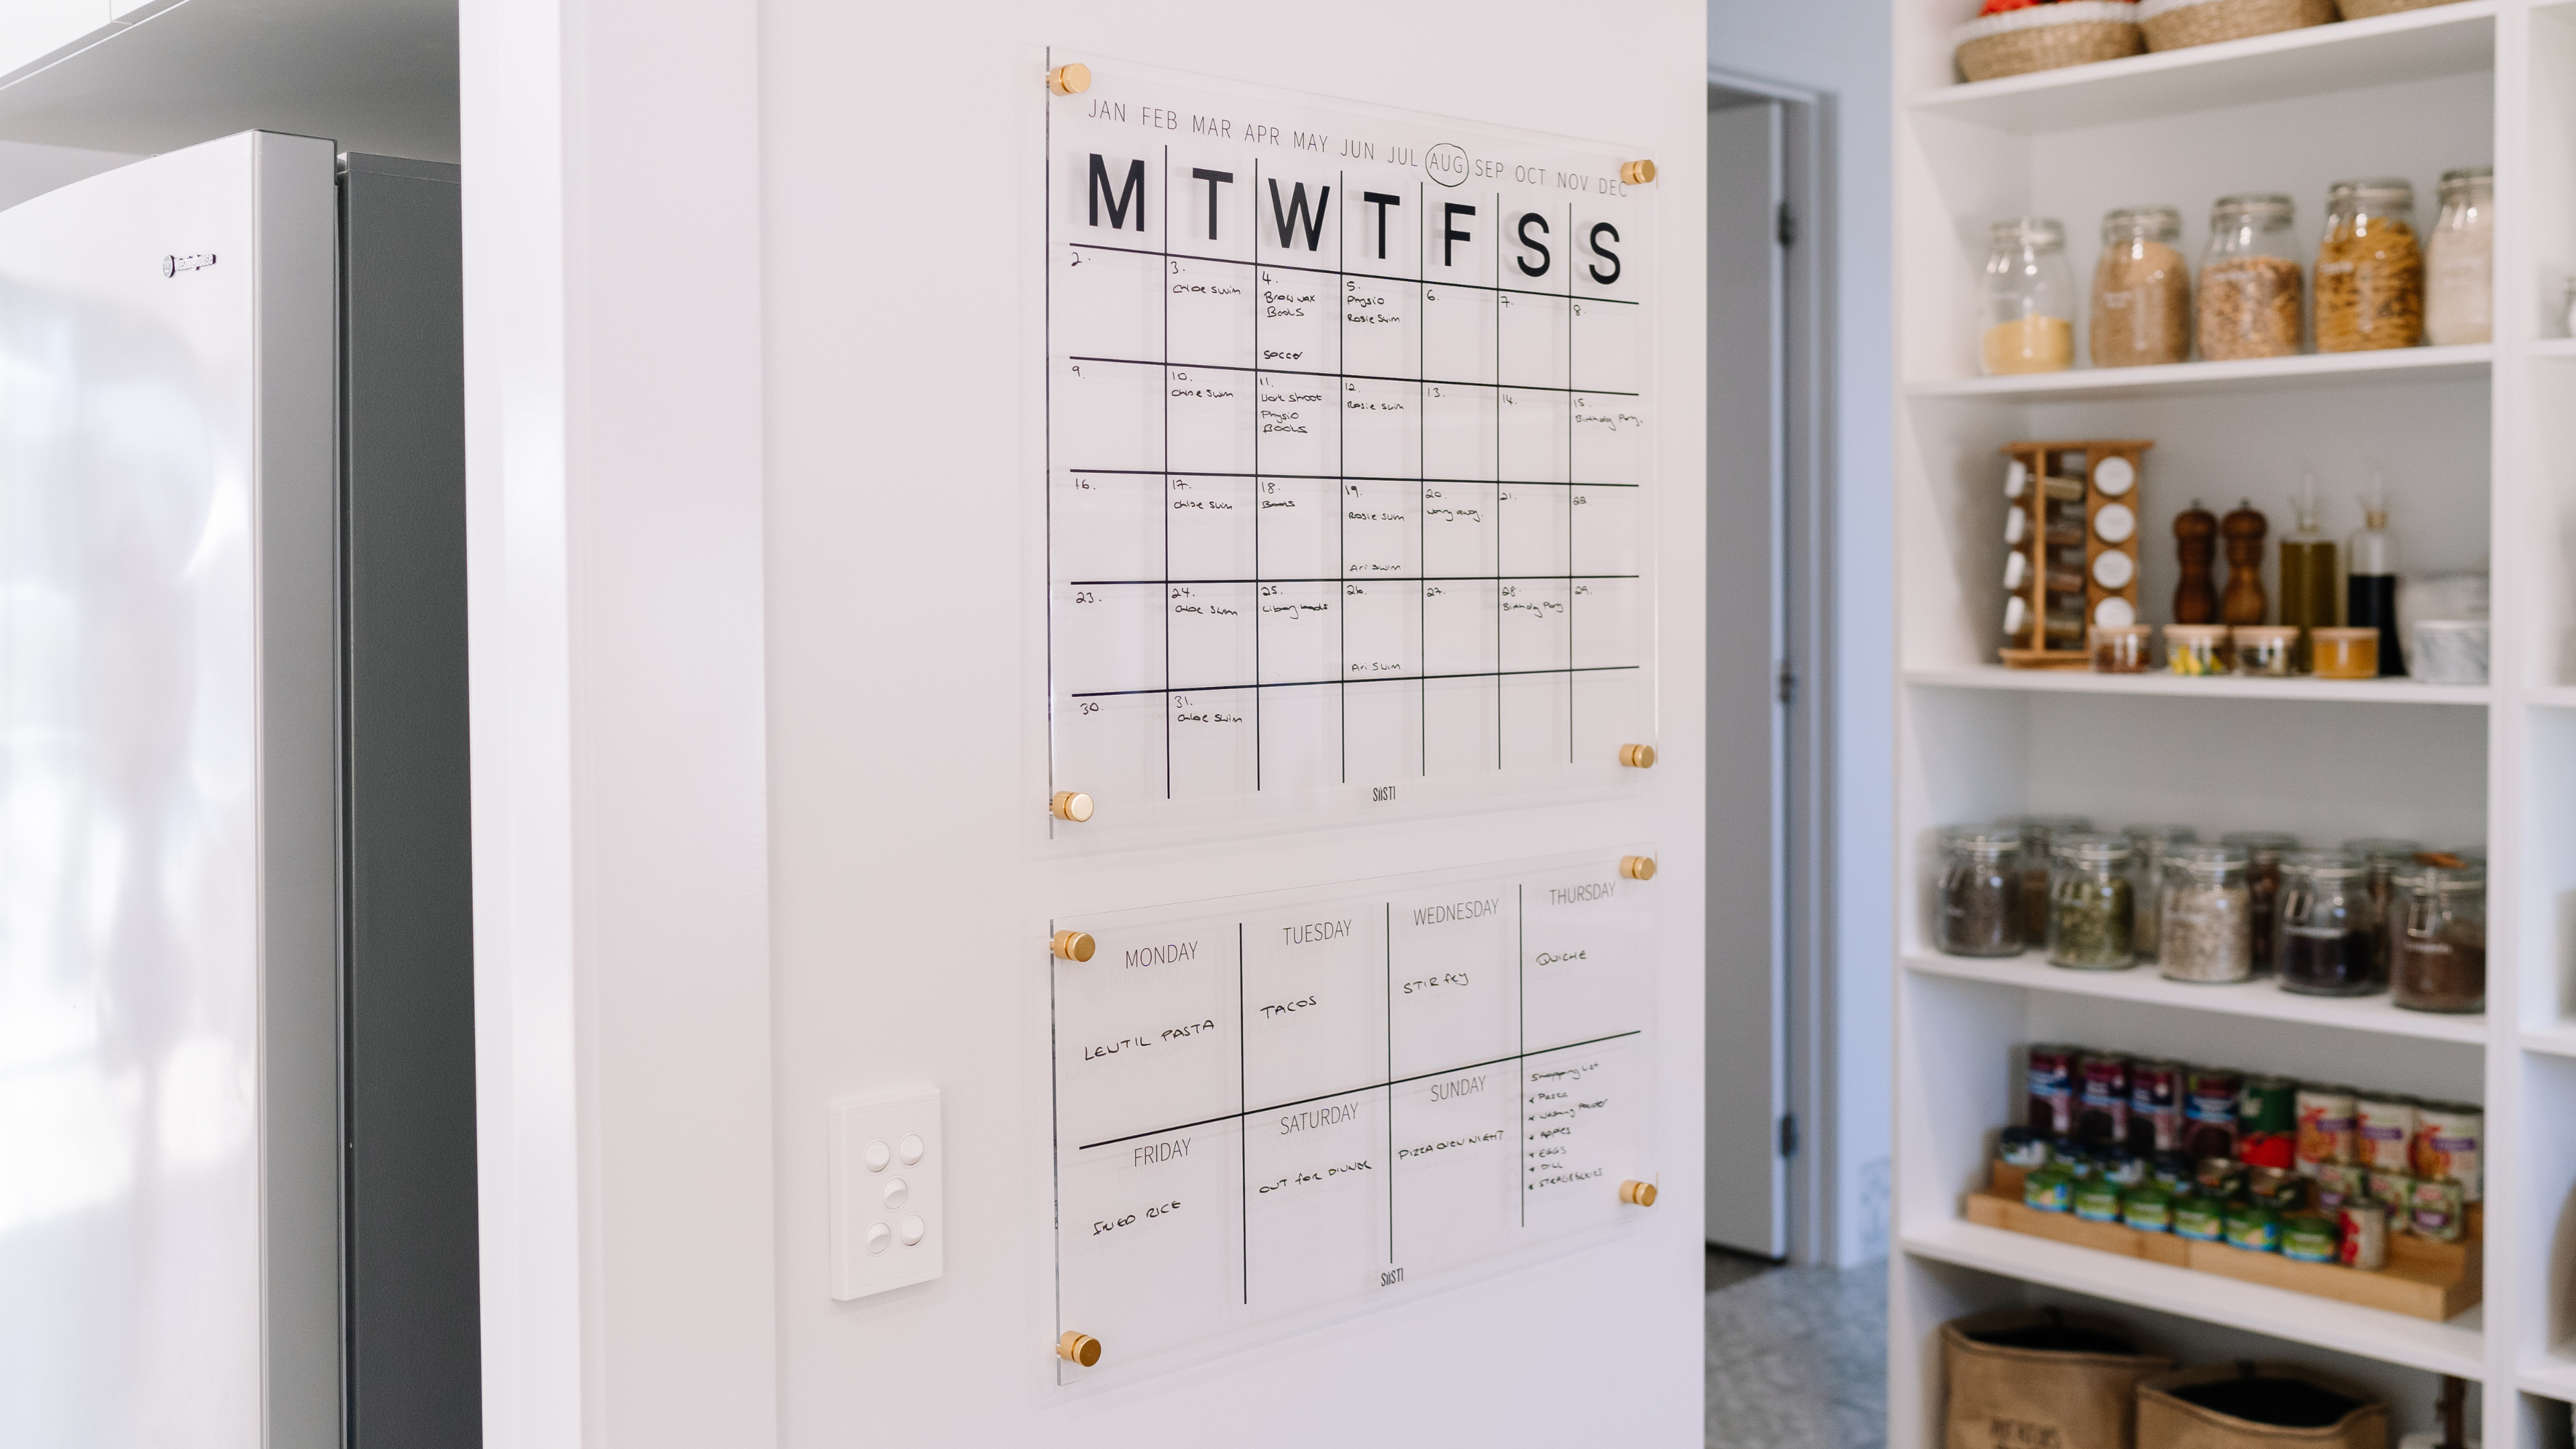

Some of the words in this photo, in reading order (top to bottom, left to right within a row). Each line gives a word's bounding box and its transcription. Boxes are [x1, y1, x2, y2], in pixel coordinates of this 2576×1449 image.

[1088, 98, 1126, 123] JAN
[1142, 106, 1177, 130] FEB
[1193, 114, 1231, 139] MAR
[1244, 123, 1279, 146] APR
[1293, 130, 1328, 153] MAY
[1340, 138, 1374, 160] JUN
[1387, 146, 1418, 167] JUL
[1430, 152, 1463, 174] AUG
[1474, 159, 1504, 178] SEP
[1515, 165, 1546, 185] OCT
[1557, 171, 1589, 191] NOV
[1599, 177, 1627, 197] DEC
[1088, 152, 1145, 233] M
[1191, 167, 1234, 241] T
[1267, 177, 1331, 252] W
[1362, 191, 1401, 260] T
[1443, 201, 1477, 267] F
[1516, 212, 1551, 278] S
[1588, 221, 1621, 286] S
[174, 254, 214, 271] Westinghouse
[1170, 260, 1185, 275] 3.
[1262, 270, 1279, 286] 4.
[1346, 280, 1361, 292] 5.
[1346, 294, 1385, 309] Physio
[1426, 288, 1440, 301] 6.
[1500, 295, 1513, 309] 7.
[1346, 313, 1375, 325] Rosie
[1071, 365, 1085, 380] 9.
[1172, 371, 1193, 382] 10.
[1259, 376, 1274, 388] 11.
[1345, 382, 1361, 393] 12.
[1428, 387, 1446, 398] 13.
[1502, 393, 1517, 406] 14.
[1346, 400, 1377, 411] Rosie
[1573, 398, 1592, 408] 15.
[1260, 410, 1299, 424] Physio
[1075, 478, 1096, 490] 16.
[1172, 479, 1192, 490] 17.
[1261, 481, 1281, 494] 18.
[1344, 484, 1362, 498] 19.
[1425, 488, 1447, 500] 20.
[1499, 492, 1517, 501] 21.
[1171, 587, 1195, 599] 24.
[1260, 585, 1283, 596] 25.
[1346, 584, 1367, 596] 26.
[1426, 587, 1446, 598] 27.
[1574, 585, 1593, 595] 29.
[1075, 591, 1102, 604] 23.
[1079, 702, 1104, 716] 30.
[1174, 695, 1193, 709] 31.
[1548, 881, 1616, 906] THURSDAY
[1413, 898, 1499, 926] WEDNESDAY
[1282, 918, 1352, 946] TUESDAY
[1126, 941, 1198, 969] MONDAY
[1403, 977, 1440, 994] STIR
[1259, 996, 1317, 1020] TACOS
[1084, 1036, 1152, 1061] LENTIL
[1161, 1019, 1215, 1042] PASTA
[1430, 1075, 1486, 1102] SUNDAY
[1279, 1102, 1358, 1135] SATURDAY
[1133, 1138, 1192, 1167] FRIDAY
[1397, 1144, 1434, 1161] PIZZA
[1468, 1130, 1505, 1144] NIGHT
[1258, 1179, 1288, 1194] OUT
[1093, 1214, 1136, 1236] FRIED
[1146, 1200, 1181, 1218] RICE
